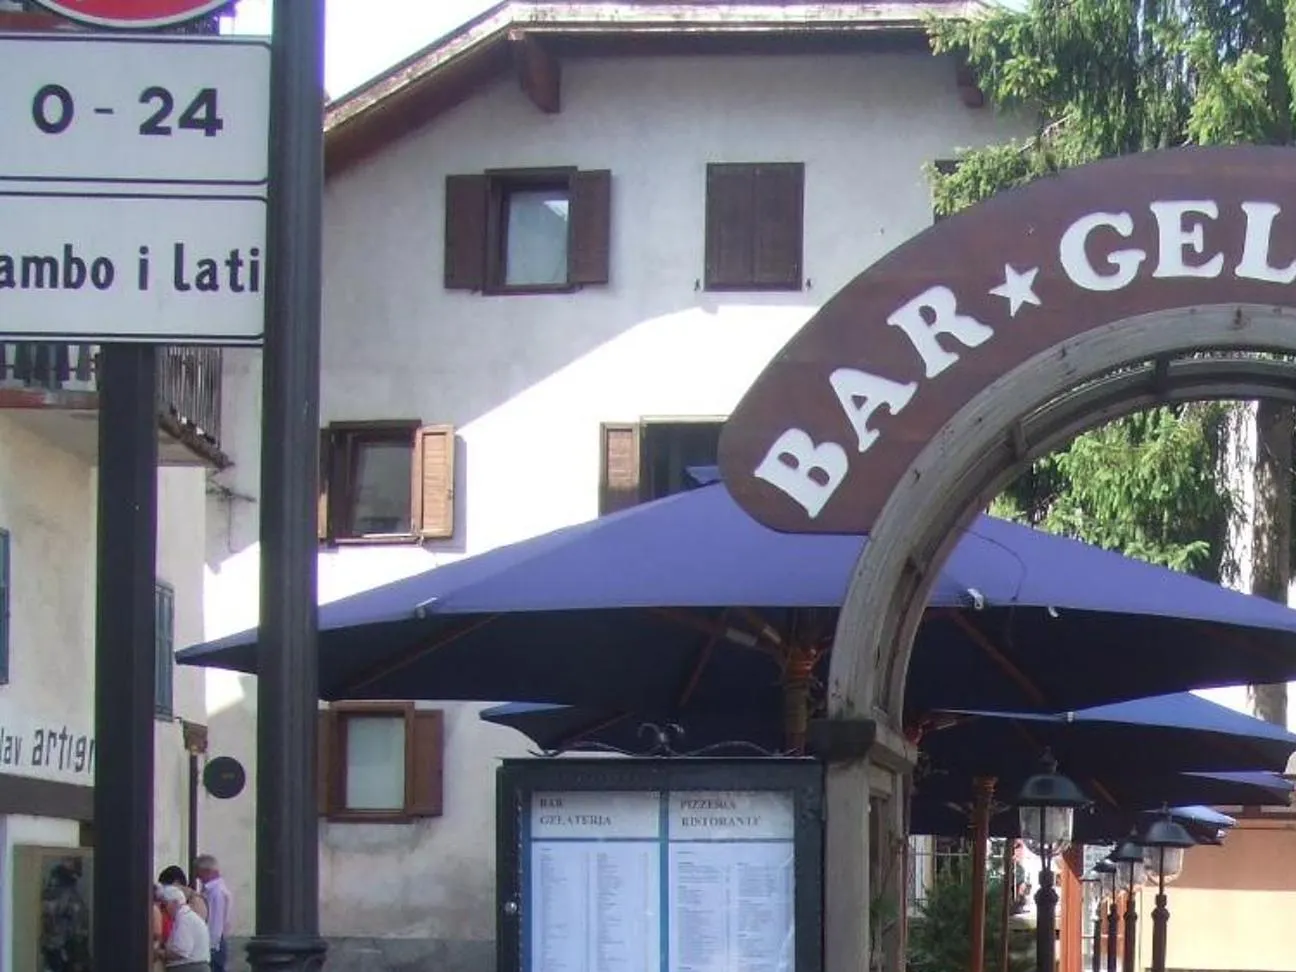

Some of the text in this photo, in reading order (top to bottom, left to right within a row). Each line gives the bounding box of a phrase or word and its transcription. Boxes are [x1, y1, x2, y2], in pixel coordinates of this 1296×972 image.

[138, 86, 224, 137] 24
[138, 246, 149, 291] i
[173, 243, 260, 293] lati
[754, 285, 994, 519] BAR
[540, 798, 564, 809] BAR
[681, 799, 736, 810] PIZZERIA
[540, 814, 612, 826] GELATERIA
[682, 815, 761, 827] RISTORANTE
